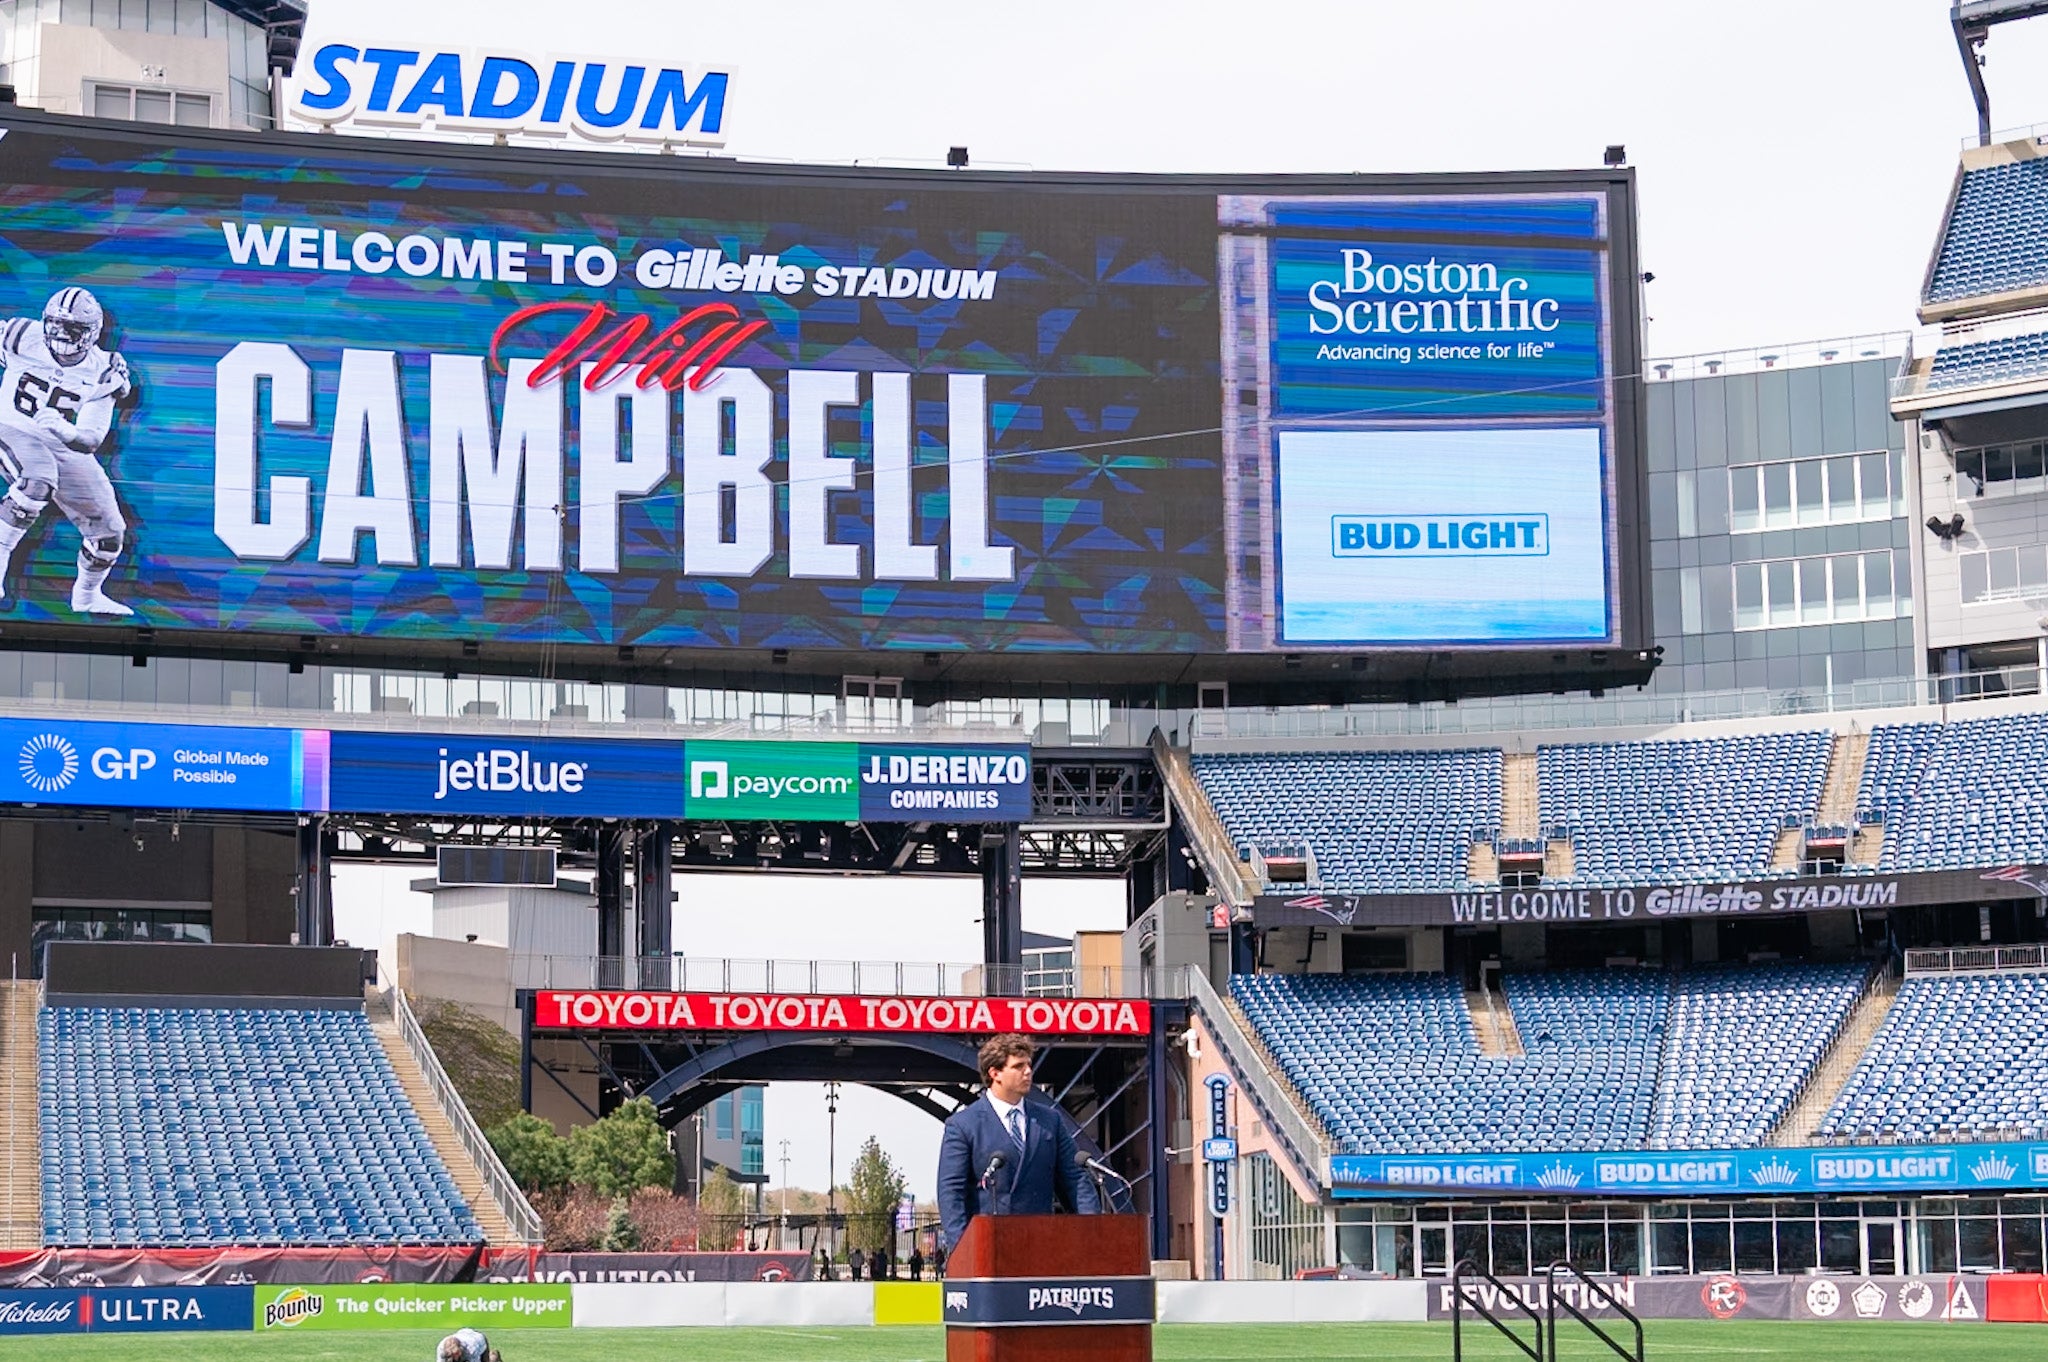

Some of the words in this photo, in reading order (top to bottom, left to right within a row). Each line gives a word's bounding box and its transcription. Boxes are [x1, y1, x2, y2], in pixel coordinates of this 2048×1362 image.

[300, 43, 728, 134] STADIUM
[221, 221, 528, 283] WELCOME
[542, 243, 618, 287] TO
[635, 248, 805, 295] Gillette
[812, 266, 998, 300] STADIUM
[1340, 249, 1500, 294] Boston
[1308, 278, 1559, 334] Scientific
[490, 301, 769, 392] Will
[1316, 344, 1411, 364] Advancing
[1417, 343, 1481, 360] science
[1487, 342, 1511, 358] for
[213, 341, 1016, 581] CAMPBELL
[1340, 523, 1420, 550] BUD
[1428, 521, 1541, 549] LIGHT
[173, 749, 222, 765] Global
[226, 751, 269, 766] Made
[862, 755, 1027, 784] J.DERENZO
[173, 769, 237, 784] Possible
[434, 748, 585, 800] jetBlue
[733, 775, 848, 798] paycom
[890, 790, 999, 809] COMPANIES
[1450, 889, 1592, 923] WELCOME
[1600, 889, 1636, 918] TO
[1645, 885, 1763, 917] Gillette
[1770, 882, 1899, 910] STADIUM
[553, 994, 696, 1026] TOYOTA
[709, 996, 848, 1028] TOYOTA
[860, 998, 996, 1030] TOYOTA
[1007, 1000, 1140, 1032] TOYOTA
[1213, 1089, 1224, 1136] BEER
[1386, 1165, 1441, 1185] BUD
[1446, 1164, 1516, 1184] LIGHT
[1600, 1163, 1655, 1183] BUD
[1657, 1161, 1732, 1181] LIGHT
[1818, 1159, 1874, 1179] BUD
[1877, 1156, 1951, 1178] LIGHT
[1215, 1162, 1226, 1210] HALL
[101, 1298, 203, 1322] ULTRA
[265, 1294, 323, 1326] Bounty
[336, 1298, 369, 1313] The
[374, 1296, 445, 1314] Quicker
[451, 1296, 507, 1313] Picker
[512, 1296, 567, 1315] Upper
[1028, 1287, 1114, 1311] PATRIOTS
[1440, 1280, 1636, 1311] REVOLUTION
